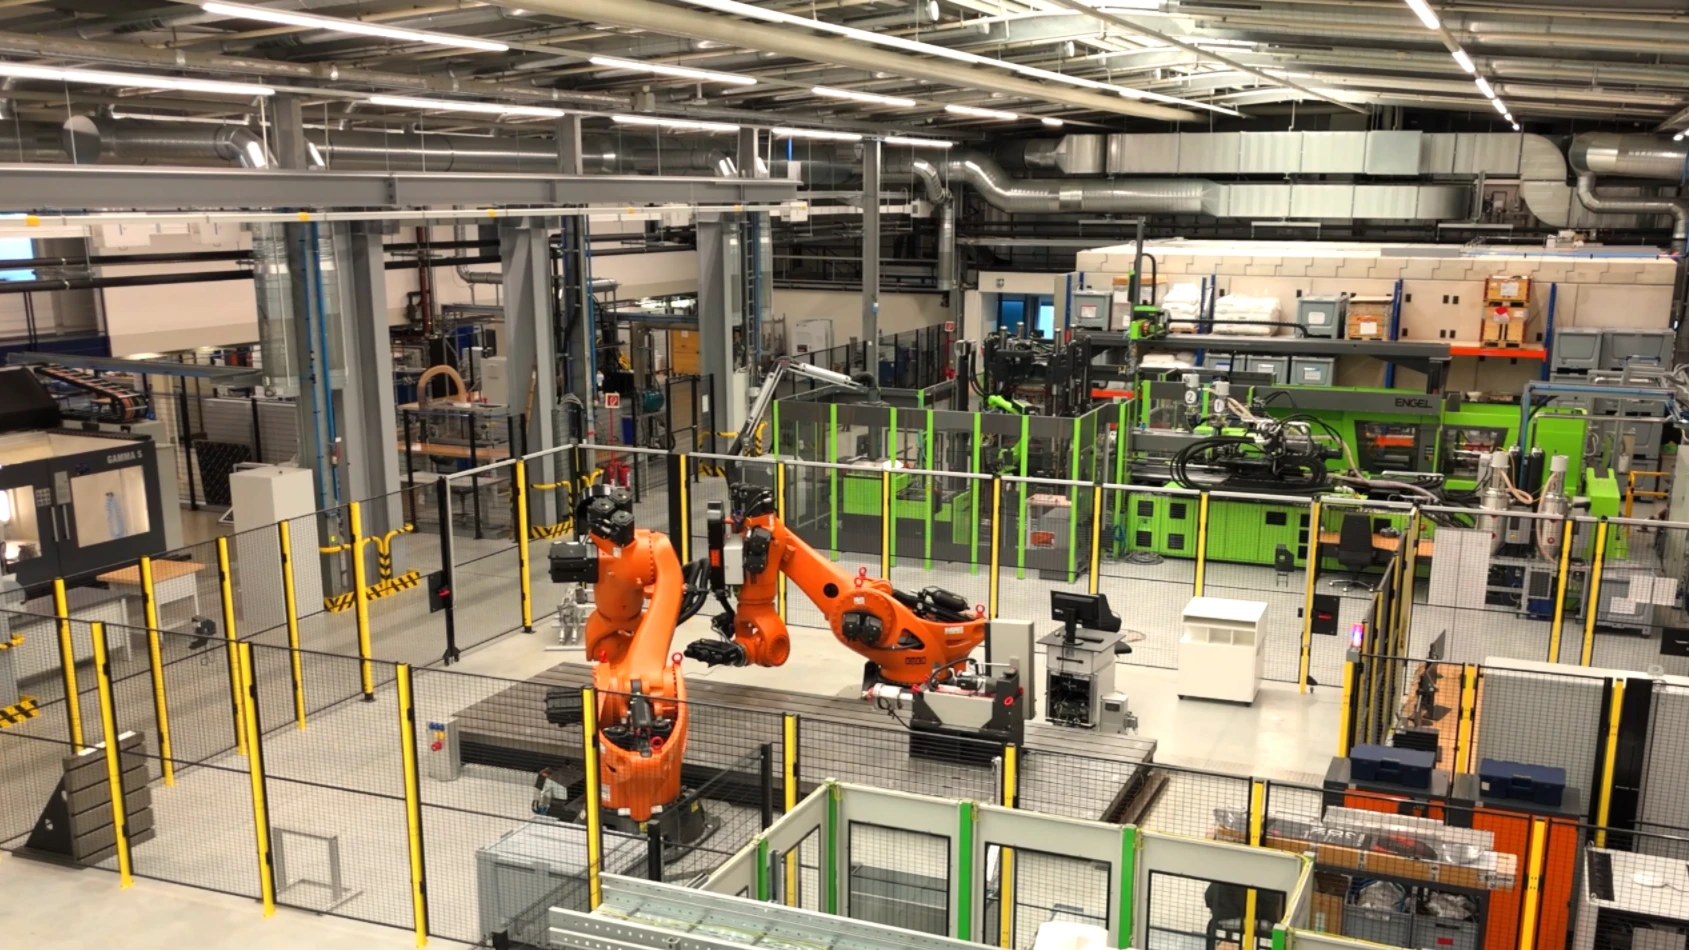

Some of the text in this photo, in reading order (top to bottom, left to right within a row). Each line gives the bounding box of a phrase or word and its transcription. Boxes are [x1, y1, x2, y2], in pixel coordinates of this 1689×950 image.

[1395, 397, 1433, 409] ENGEL
[107, 450, 143, 464] GAMMA S
